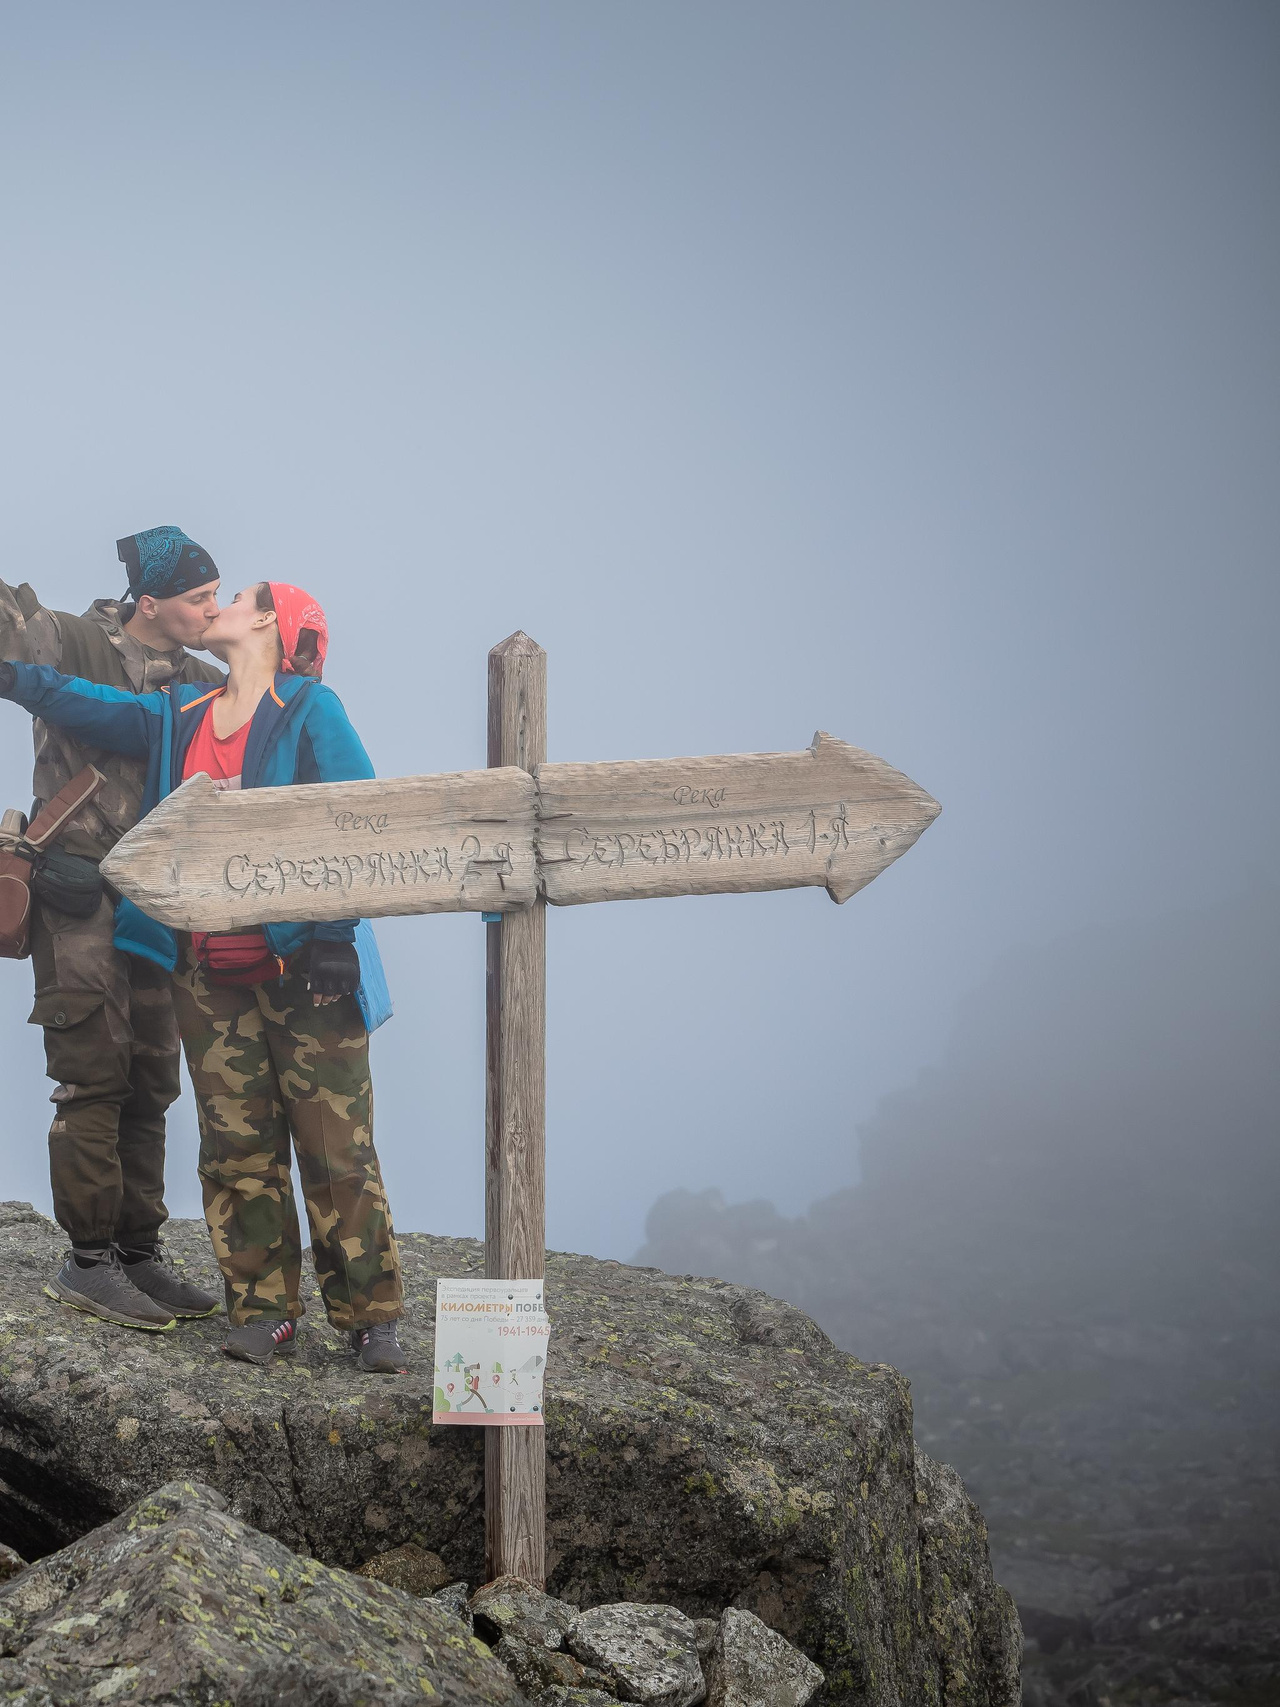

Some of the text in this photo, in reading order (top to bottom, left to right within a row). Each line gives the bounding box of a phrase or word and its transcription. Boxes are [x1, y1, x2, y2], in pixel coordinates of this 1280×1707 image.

[673, 784, 728, 808] Река
[335, 811, 390, 834] Река
[440, 1302, 545, 1313] КИЛОМЕТРЫ ПОБЕ
[484, 1315, 508, 1323] Победы
[497, 1325, 550, 1337] 1941-1945
